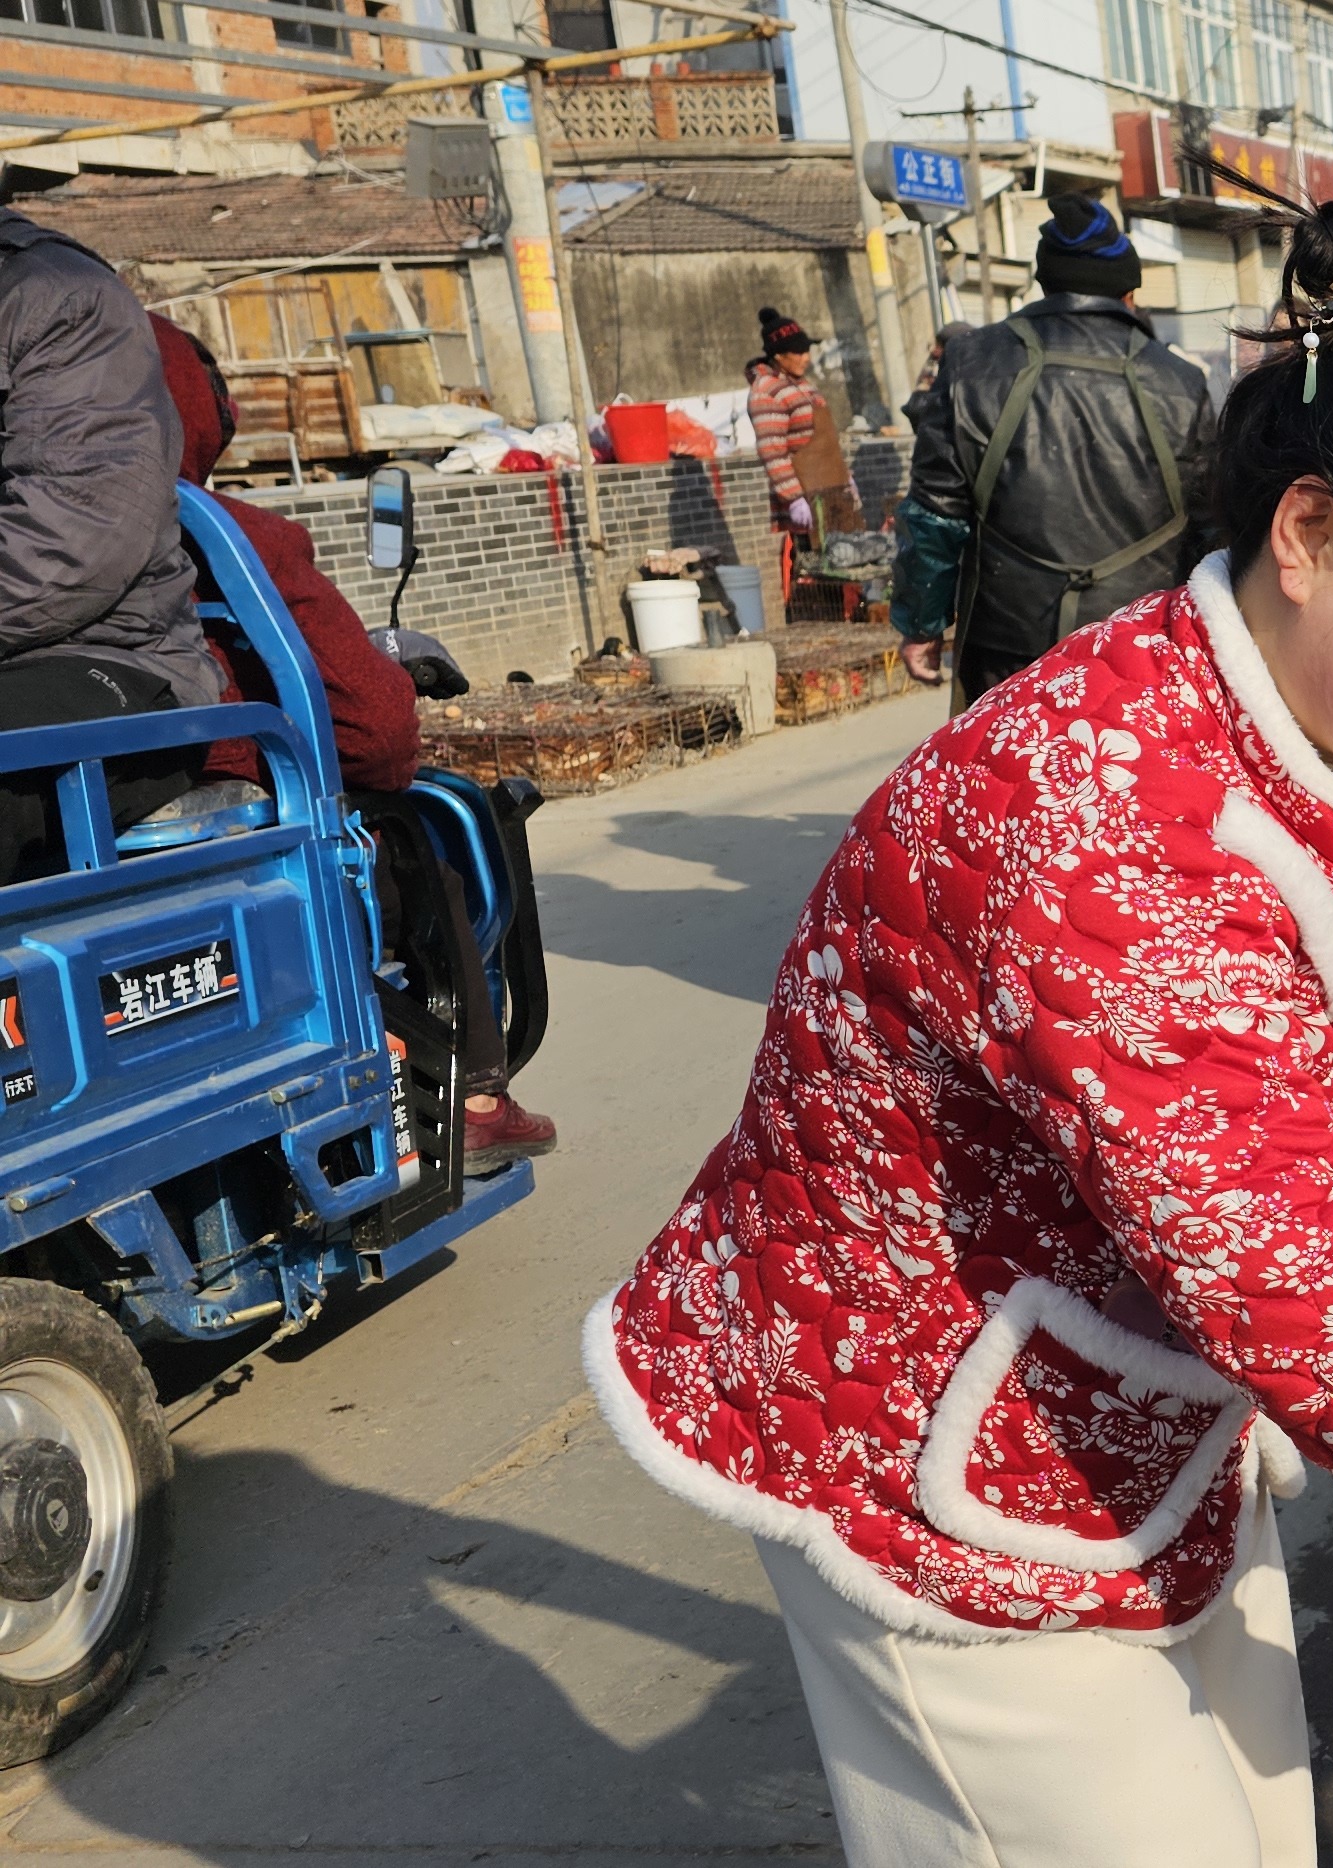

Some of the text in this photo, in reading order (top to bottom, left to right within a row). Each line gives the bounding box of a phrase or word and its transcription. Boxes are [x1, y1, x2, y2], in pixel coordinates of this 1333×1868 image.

[901, 150, 956, 189] 公正街
[119, 955, 220, 1021] 岩江车辆
[4, 1074, 34, 1098] 行天下
[389, 1049, 411, 1157] 岩江车辆
